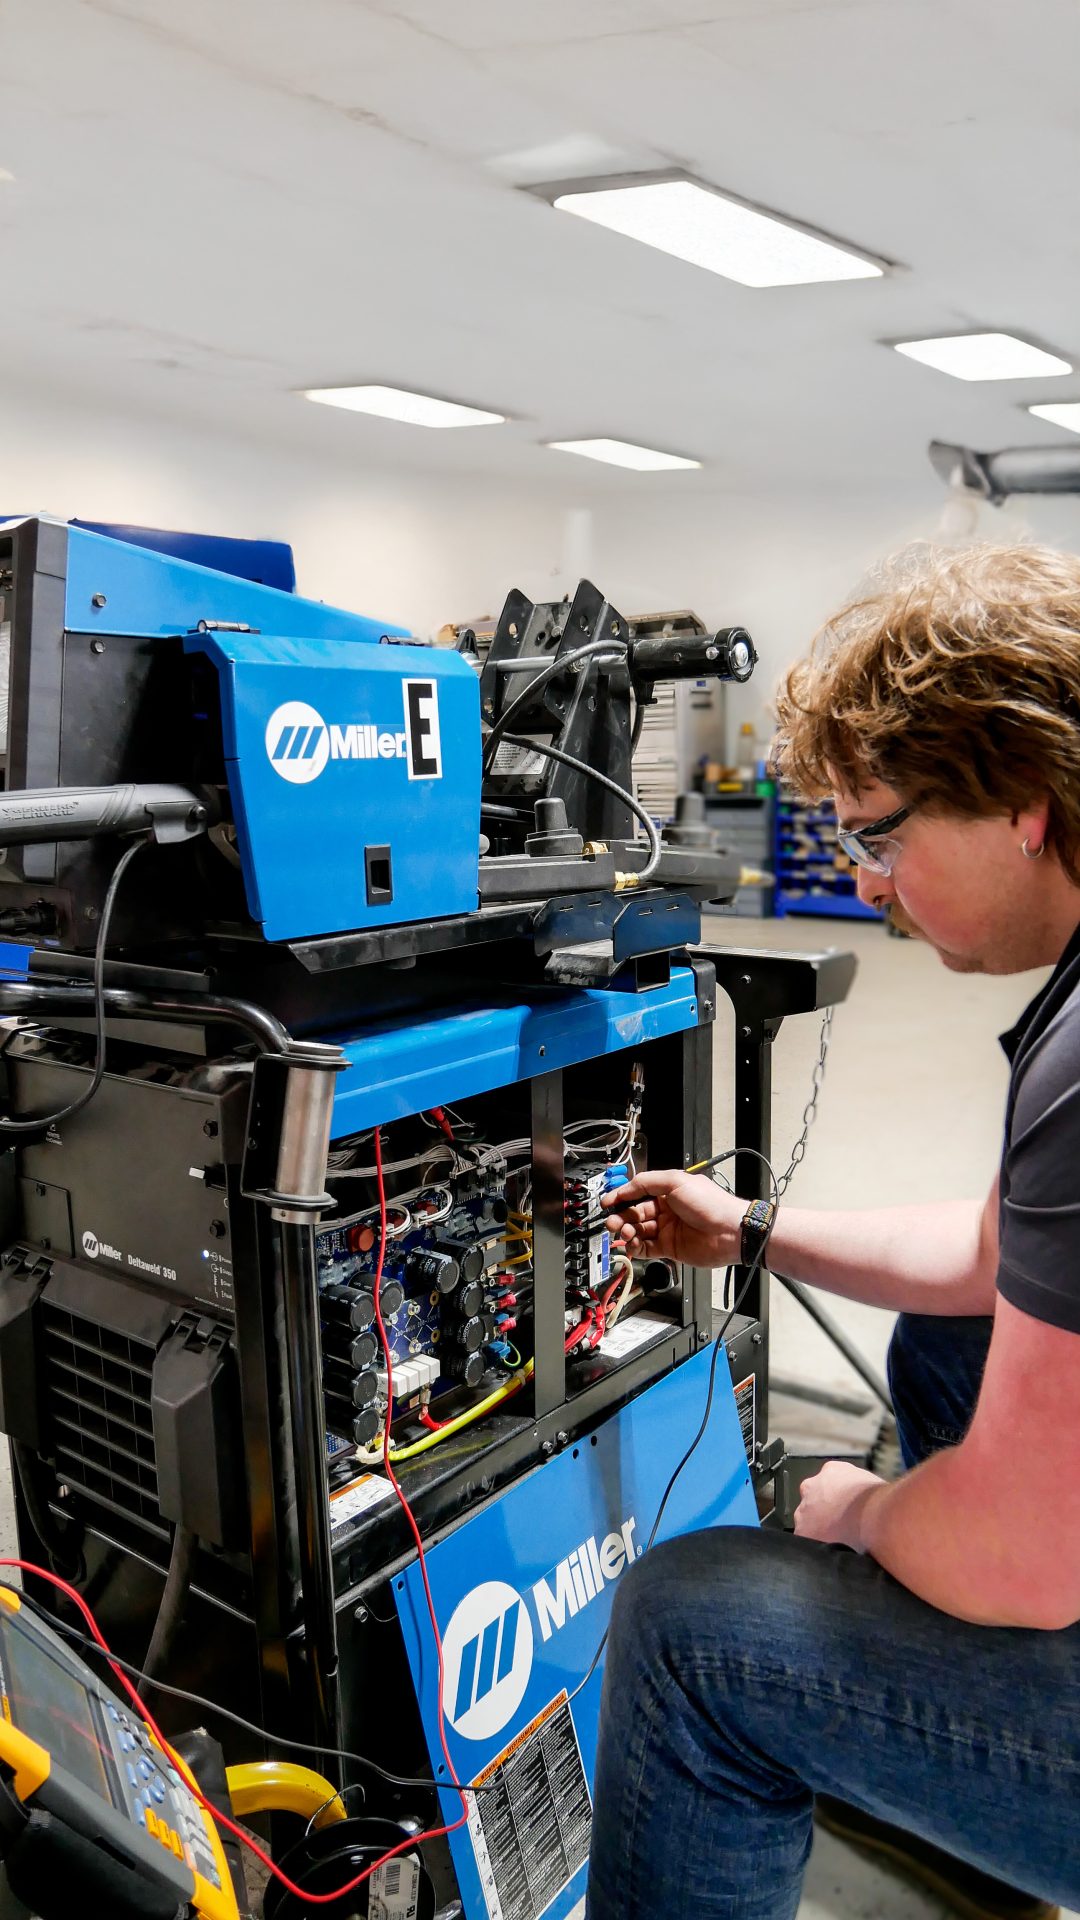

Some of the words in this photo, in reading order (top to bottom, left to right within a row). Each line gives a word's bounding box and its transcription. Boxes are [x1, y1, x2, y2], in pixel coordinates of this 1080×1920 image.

[329, 724, 407, 759] Miller
[407, 683, 438, 776] E
[99, 1242, 122, 1261] Miller
[128, 1254, 161, 1275] Deltaweld
[162, 1267, 177, 1281] 350
[532, 1516, 637, 1643] Miller
